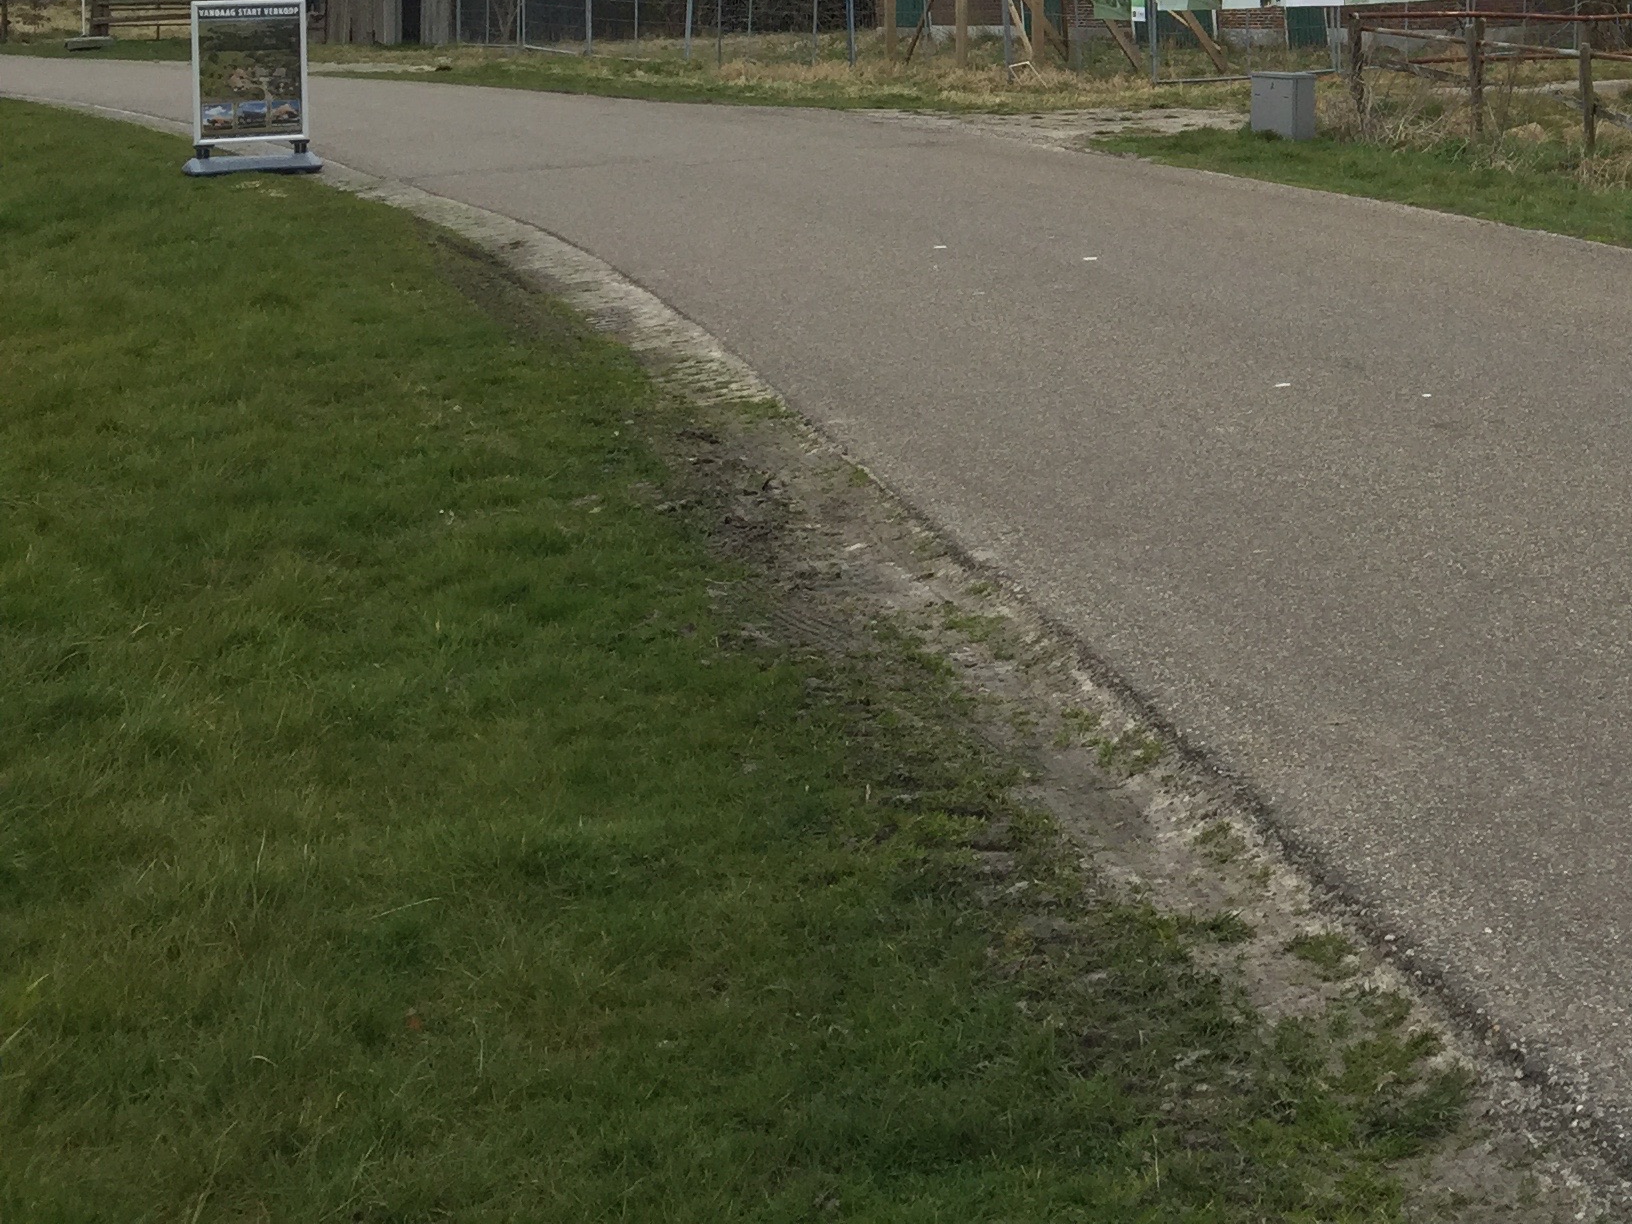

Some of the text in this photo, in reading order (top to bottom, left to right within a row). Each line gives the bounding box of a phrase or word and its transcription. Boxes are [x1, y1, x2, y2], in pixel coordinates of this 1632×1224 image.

[199, 6, 299, 17] VANDAAG START VERKOOP
